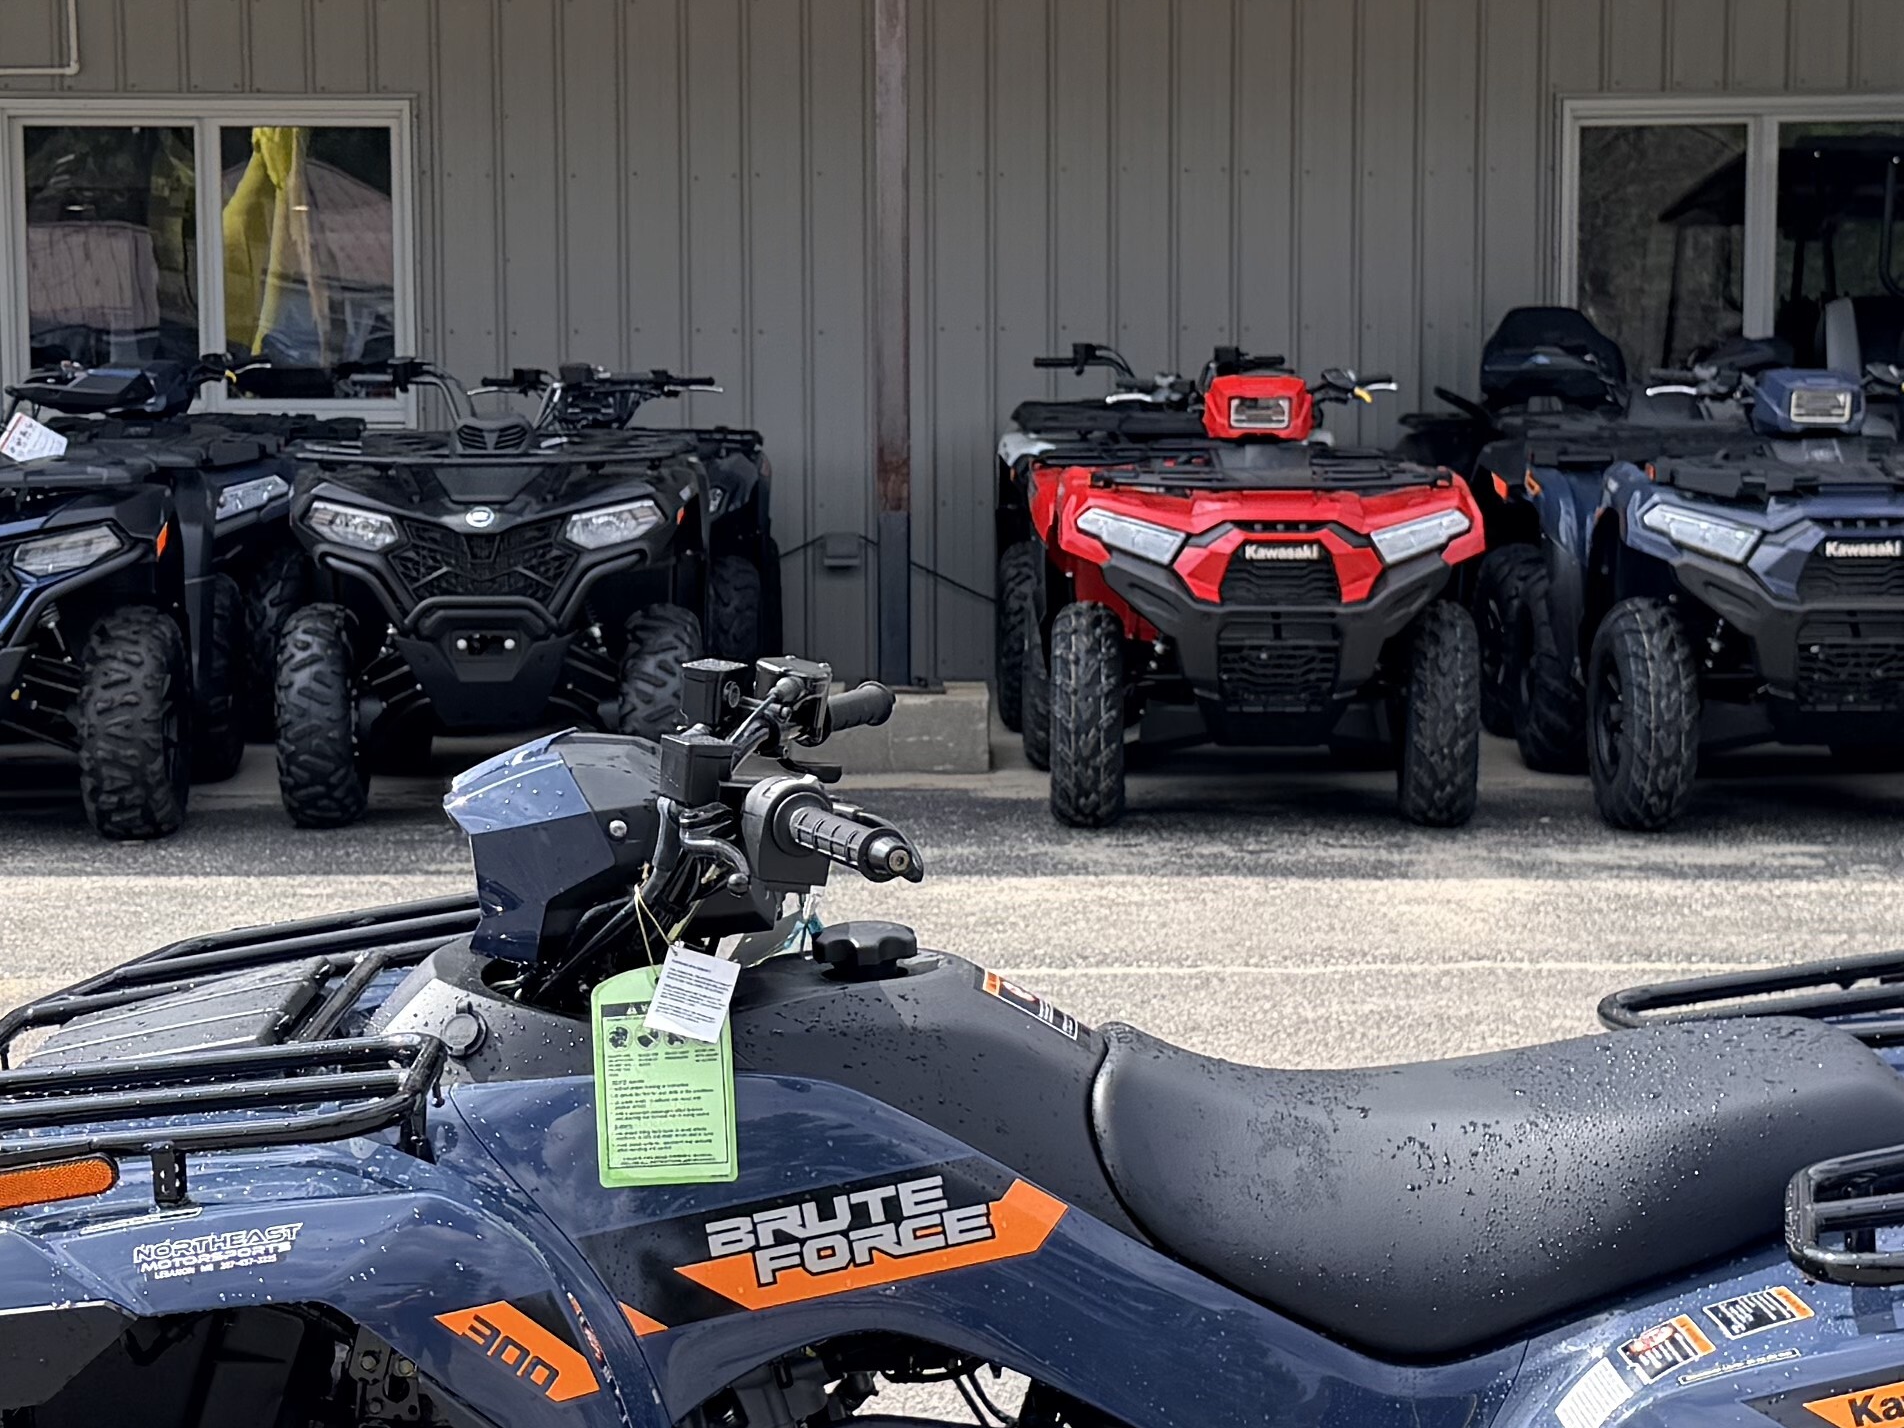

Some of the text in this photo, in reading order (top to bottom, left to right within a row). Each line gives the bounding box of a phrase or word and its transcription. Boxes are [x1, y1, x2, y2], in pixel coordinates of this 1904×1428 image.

[1245, 543, 1319, 560] Kawasaki
[1825, 540, 1902, 557] Kawasaki
[704, 1174, 949, 1258] BRUTE
[133, 1222, 304, 1264] NORTHEAST
[141, 1241, 292, 1273] MOTORSPORTS
[754, 1202, 995, 1286] FORCE
[465, 1313, 560, 1395] 300
